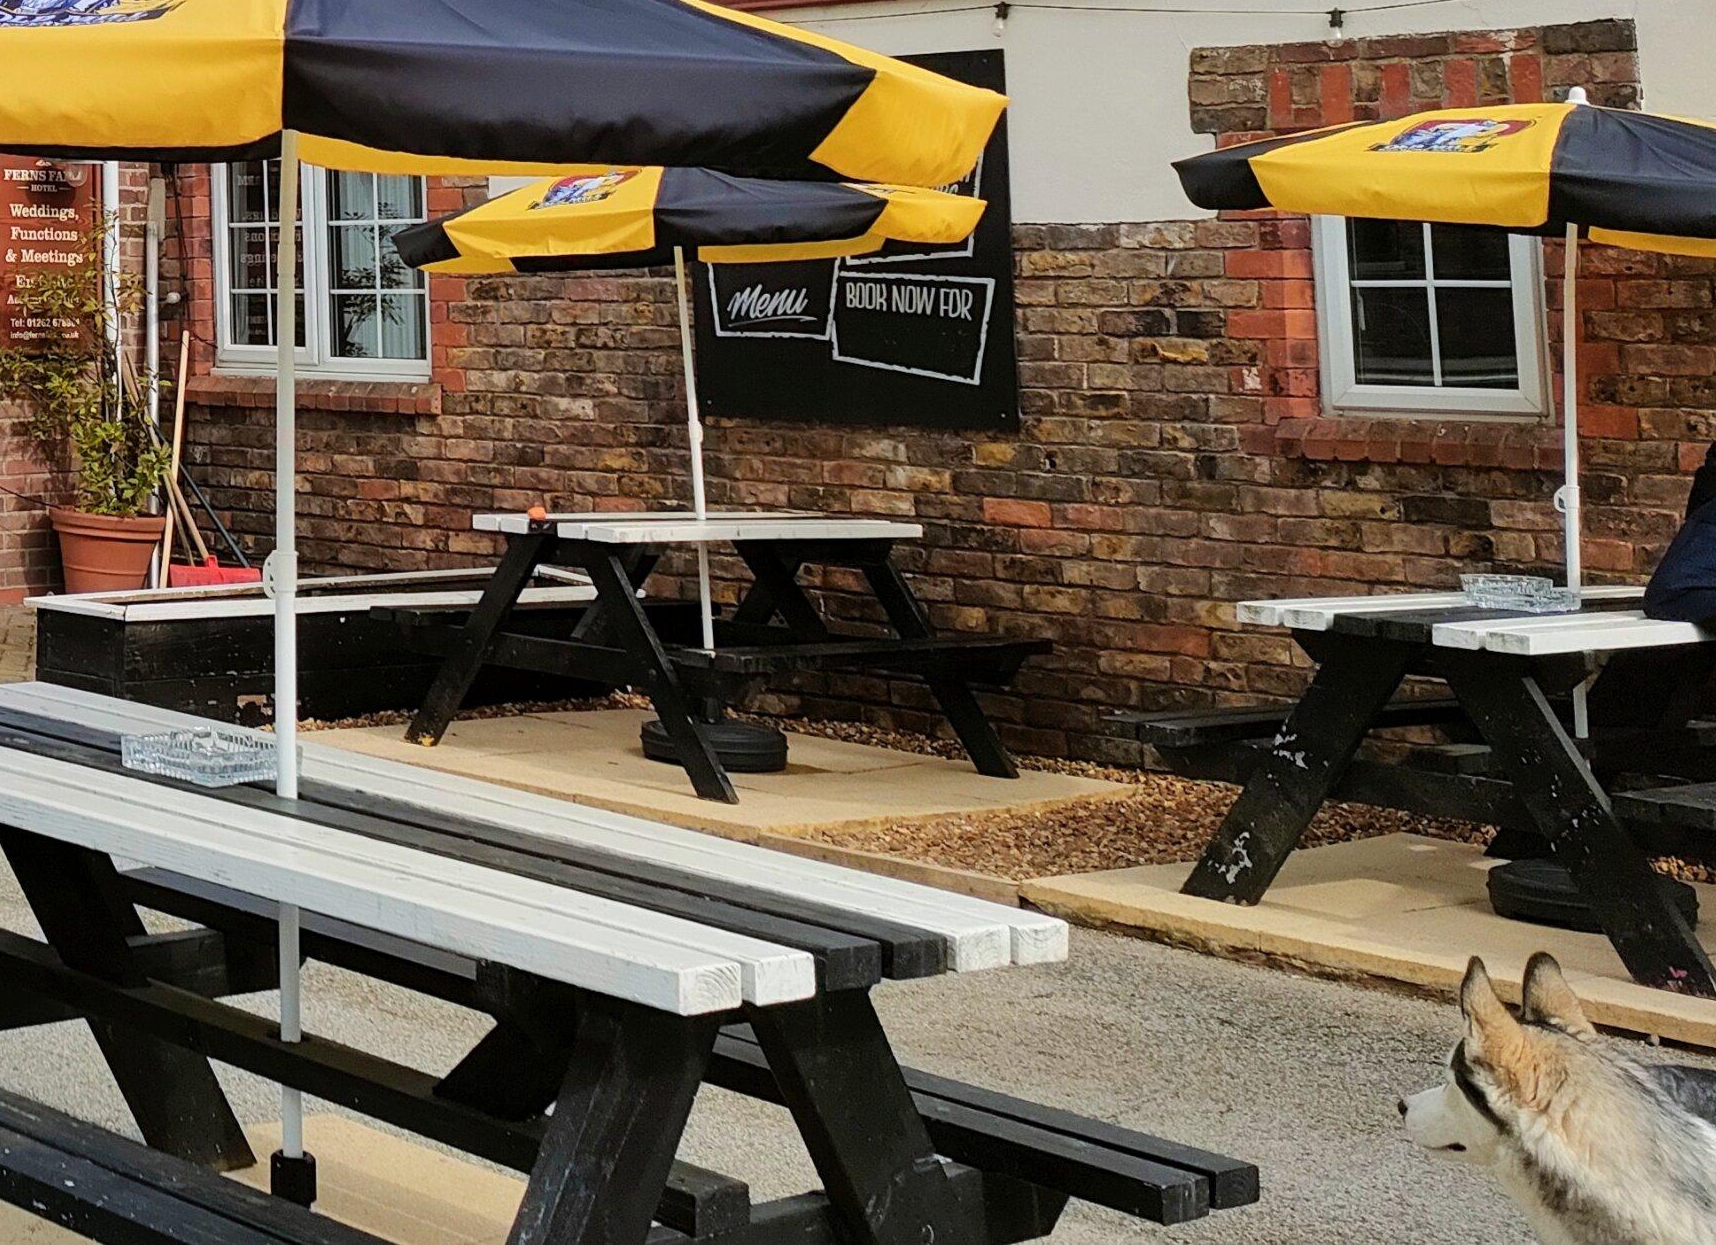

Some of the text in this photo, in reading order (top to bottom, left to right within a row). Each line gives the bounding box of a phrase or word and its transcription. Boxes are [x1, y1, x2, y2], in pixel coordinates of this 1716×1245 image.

[3, 168, 46, 182] FERNS
[30, 184, 57, 192] HOTEL
[9, 203, 79, 221] Weddings,
[10, 226, 78, 241] Functions
[5, 248, 84, 267] & Meetings
[727, 284, 809, 321] Menu
[846, 282, 973, 321] BOOK NOW FOR
[10, 318, 25, 328] Tel:
